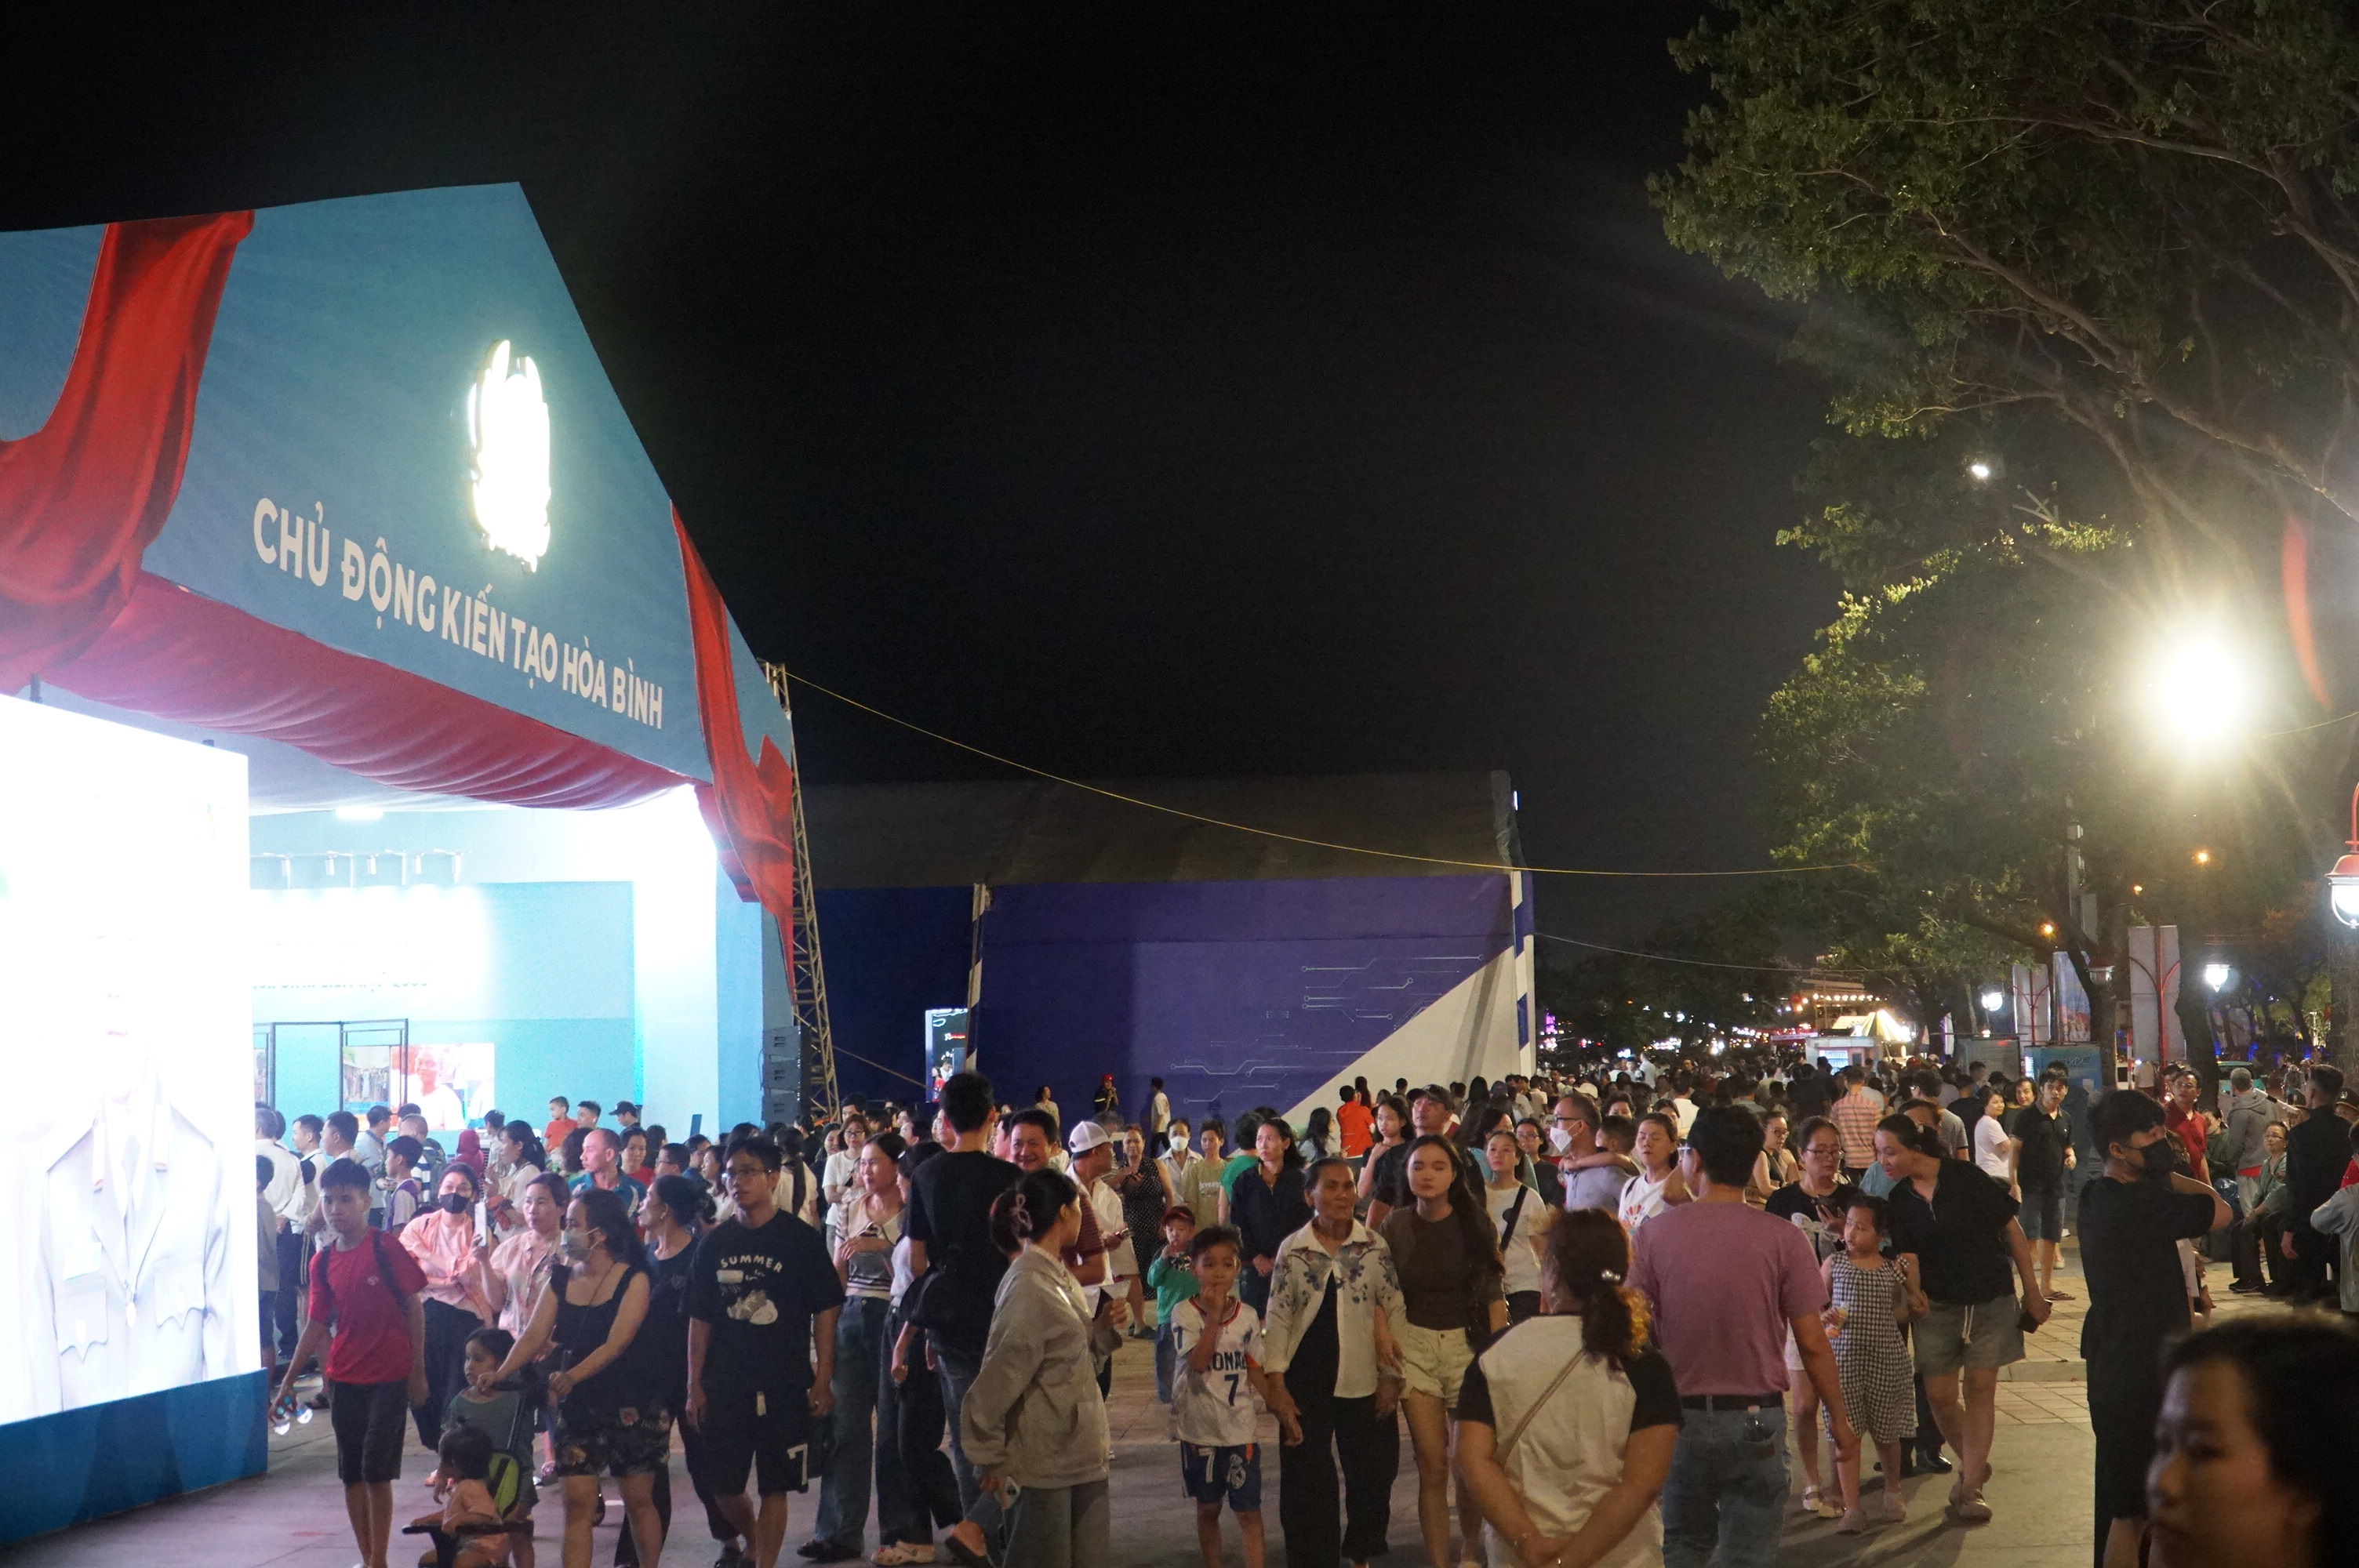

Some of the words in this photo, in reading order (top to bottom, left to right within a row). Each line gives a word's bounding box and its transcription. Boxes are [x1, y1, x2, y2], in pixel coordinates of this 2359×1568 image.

[253, 497, 330, 587] CHỦ
[340, 536, 438, 633] ĐỘNG
[441, 583, 507, 664] KIẾN
[511, 617, 558, 689] TẠO
[562, 635, 608, 709] HÒA
[612, 657, 663, 731] BÌNH
[720, 1254, 783, 1273] SUMMER
[1223, 1374, 1239, 1406] 7
[786, 1443, 809, 1486] 7
[1198, 1446, 1216, 1484] 7
